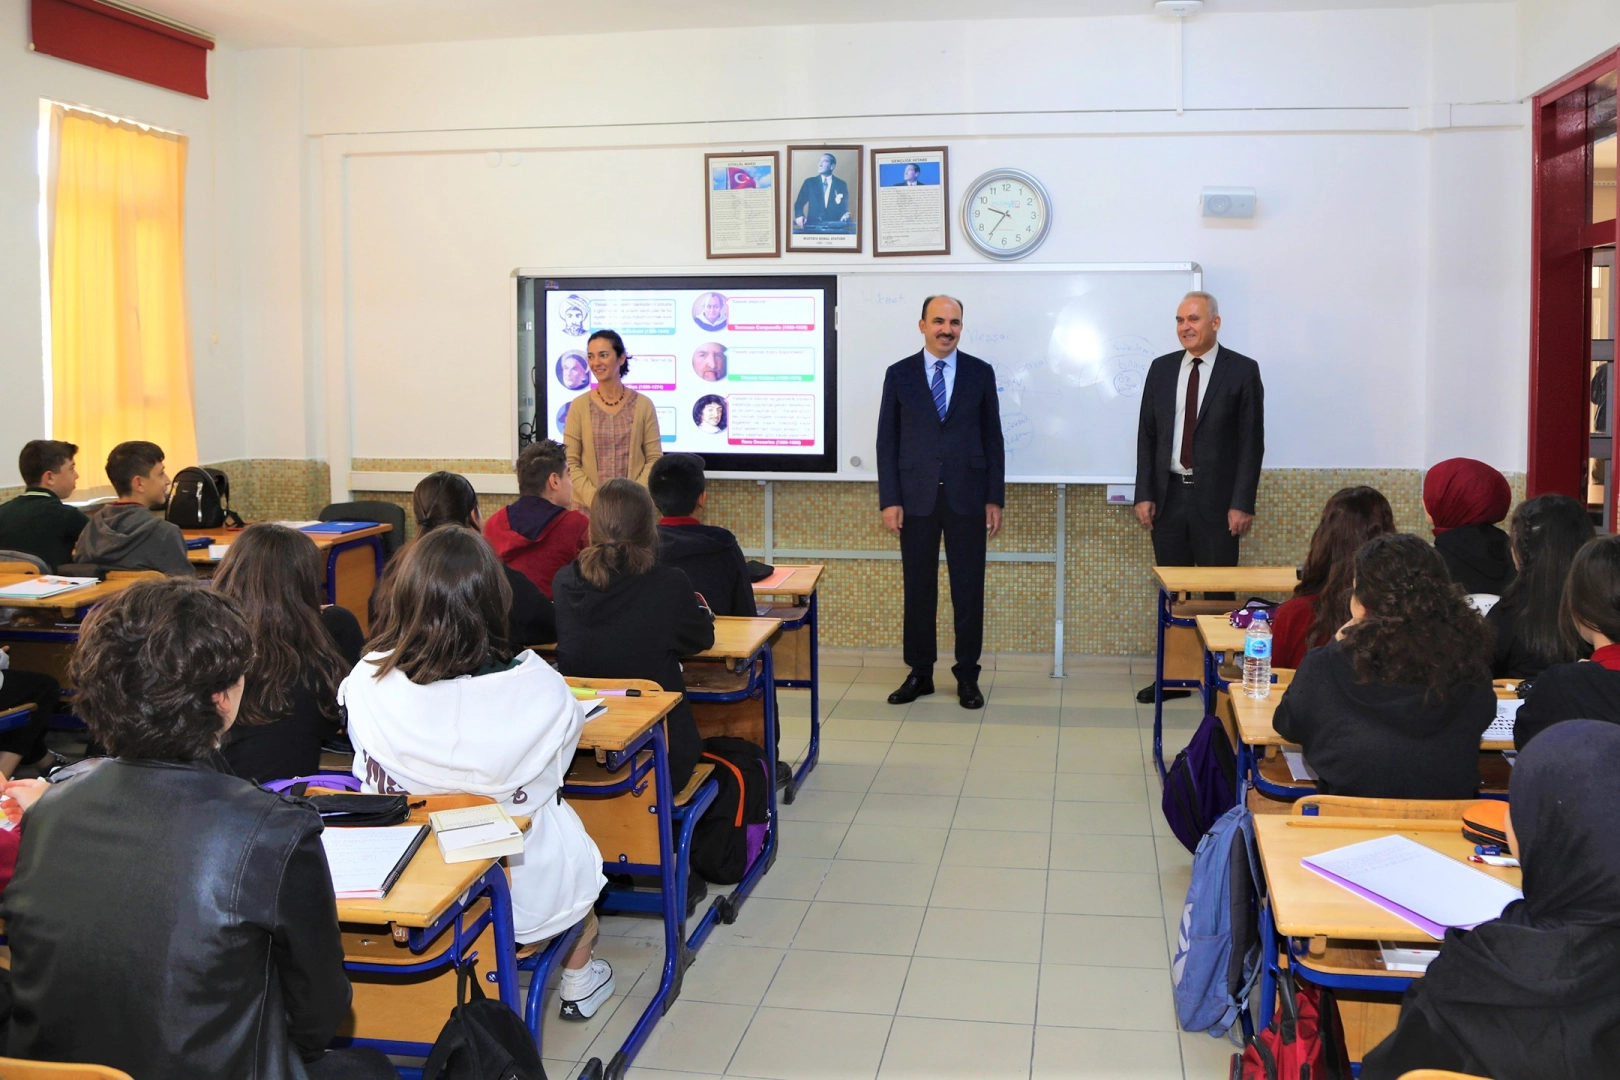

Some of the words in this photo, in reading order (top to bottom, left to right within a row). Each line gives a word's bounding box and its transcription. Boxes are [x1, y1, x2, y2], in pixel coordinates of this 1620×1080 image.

[990, 187, 997, 195] 11
[1002, 183, 1012, 192] 12
[980, 196, 988, 204] 10
[1027, 197, 1033, 206] 2
[974, 209, 980, 218] 9
[1030, 211, 1037, 220] 3
[978, 223, 985, 231] 8
[1025, 225, 1031, 233] 4
[989, 232, 994, 241] 7
[1015, 233, 1021, 242] 5
[1001, 237, 1007, 246] 6
